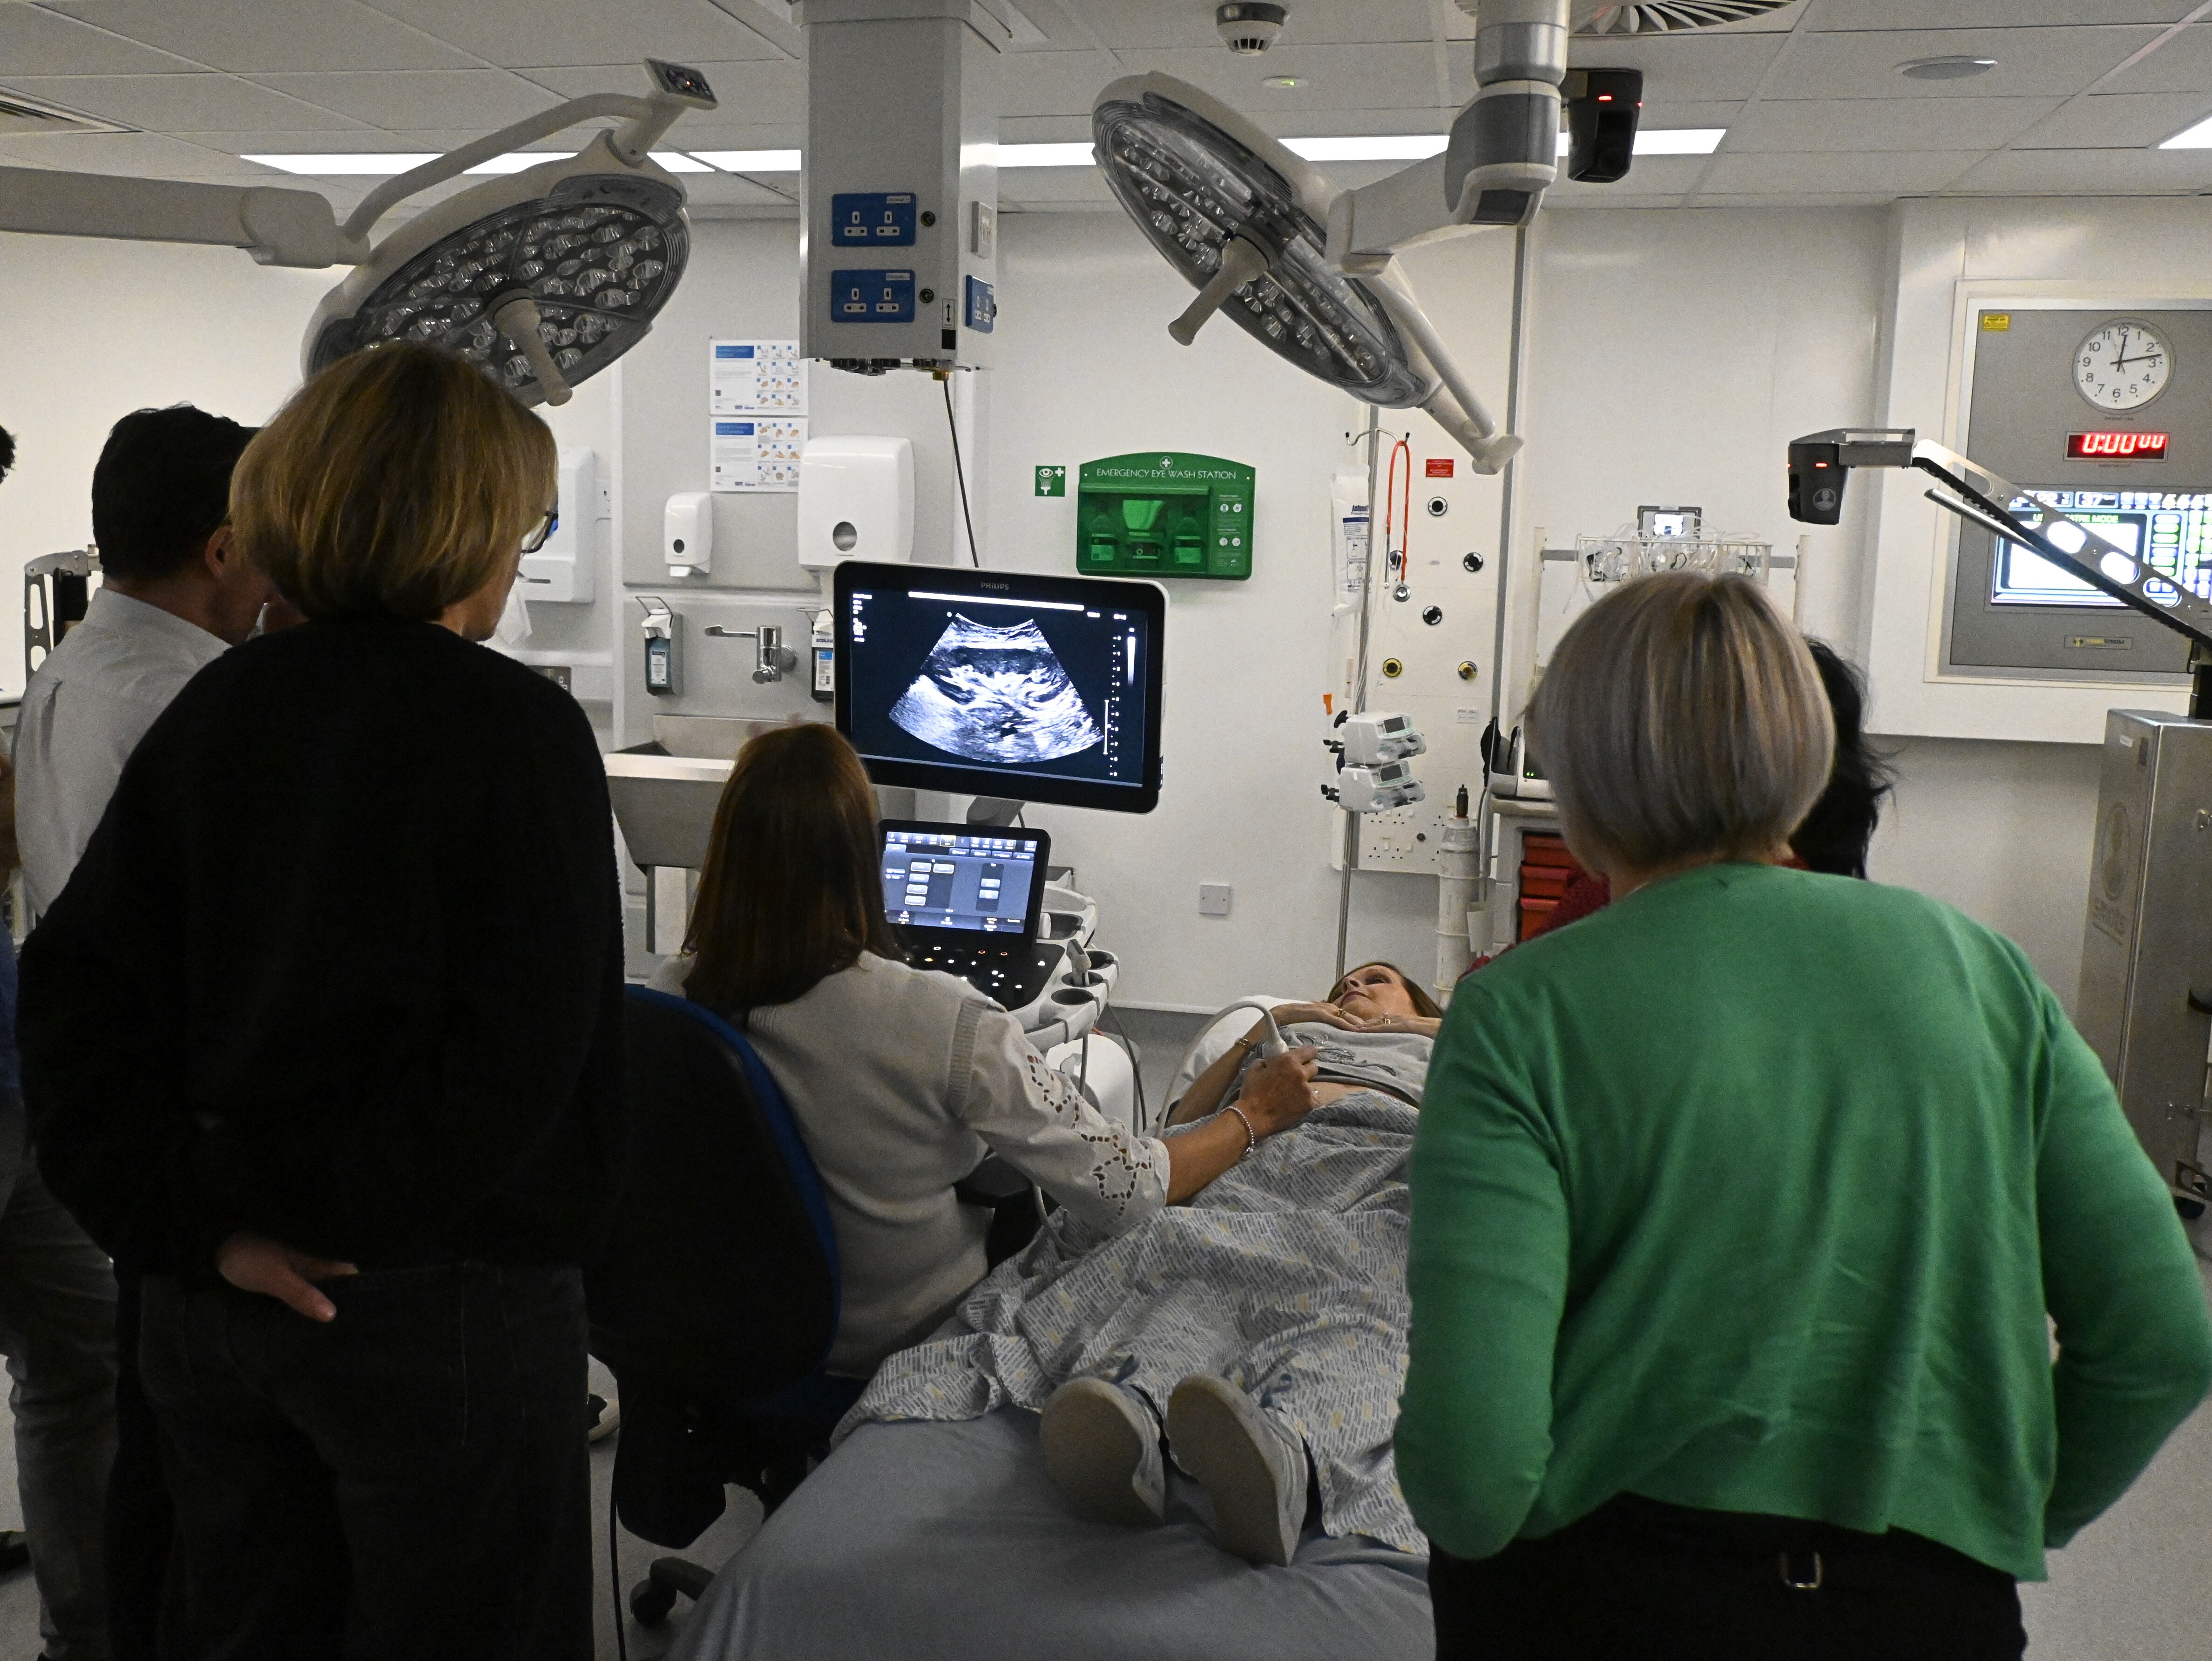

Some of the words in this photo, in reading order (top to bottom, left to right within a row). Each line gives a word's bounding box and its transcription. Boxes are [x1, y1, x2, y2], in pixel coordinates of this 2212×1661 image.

[2103, 331, 2110, 340] 11
[2118, 326, 2129, 336] 12
[2138, 331, 2140, 340] 1
[2089, 342, 2101, 352] 10
[2146, 342, 2155, 352] 2
[2083, 357, 2091, 367] 9
[2149, 359, 2156, 367] 3
[2085, 373, 2093, 382] 8
[2143, 374, 2150, 382] 4
[2097, 384, 2104, 393] 7
[2112, 388, 2120, 398] 6
[2130, 384, 2137, 393] 5
[1097, 468, 1149, 477] EMERGENCY
[1198, 471, 1236, 479] STATION
[2092, 515, 2119, 523] MODE
